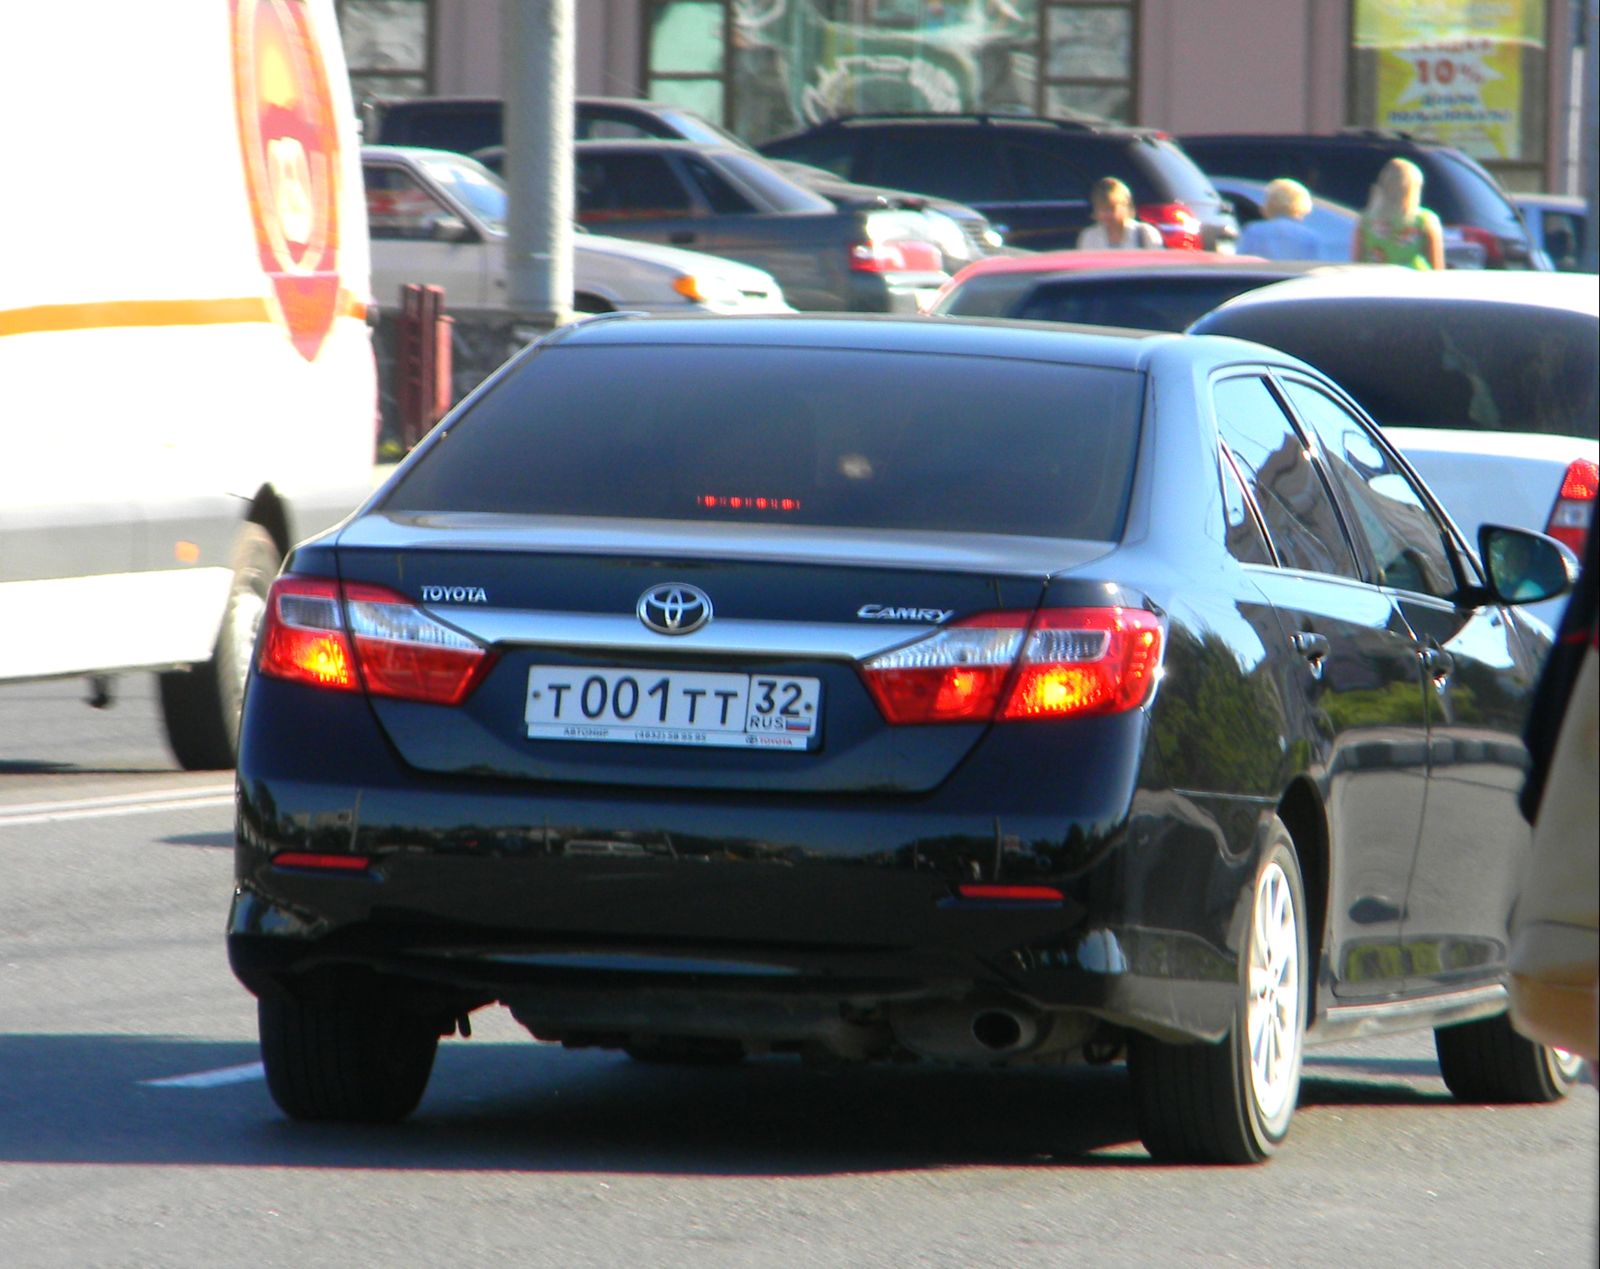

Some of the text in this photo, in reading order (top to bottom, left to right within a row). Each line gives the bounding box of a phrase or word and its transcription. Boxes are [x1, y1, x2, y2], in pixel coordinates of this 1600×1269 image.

[1416, 59, 1484, 85] 10%
[420, 585, 488, 603] TOYOTA
[857, 603, 953, 623] CAMRY
[548, 675, 803, 724] T001TT 32
[750, 715, 784, 729] RUS
[759, 735, 793, 746] TOYOTA
